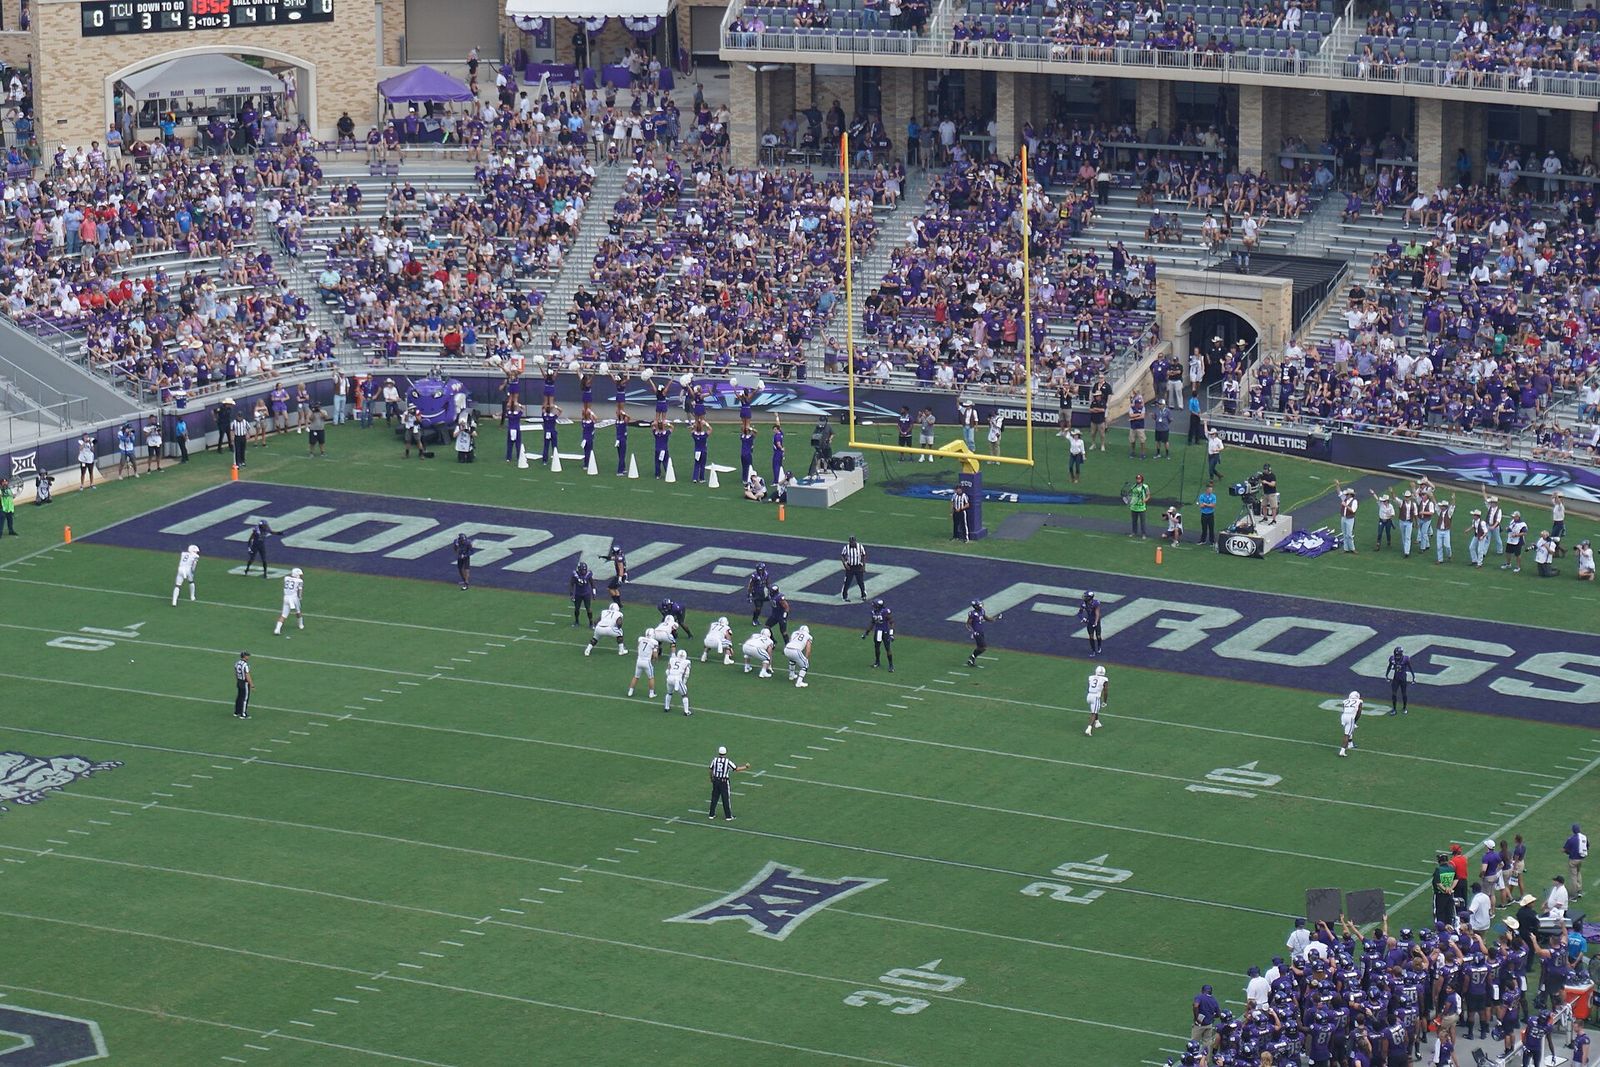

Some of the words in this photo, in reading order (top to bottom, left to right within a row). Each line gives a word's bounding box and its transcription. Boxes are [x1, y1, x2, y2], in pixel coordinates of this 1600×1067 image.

[110, 4, 133, 17] TCU
[137, 3, 160, 12] DOWN
[162, 2, 171, 11] TO
[173, 1, 184, 11] GO
[271, 6, 276, 20] 1
[322, 0, 332, 13] 0
[93, 10, 104, 27] 0
[142, 12, 152, 29] 3
[171, 12, 181, 26] 4
[223, 14, 230, 28] 3
[246, 7, 256, 21] 4
[188, 16, 196, 29] 3
[202, 17, 216, 27] TOL
[1232, 540, 1249, 550] FOX
[158, 499, 921, 606] HORNED
[944, 582, 1600, 704] FROGS
[1343, 700, 1357, 708] 22
[716, 762, 724, 772] R
[1019, 862, 1135, 905] 20
[1472, 971, 1488, 985] 97
[842, 967, 966, 1015] 30
